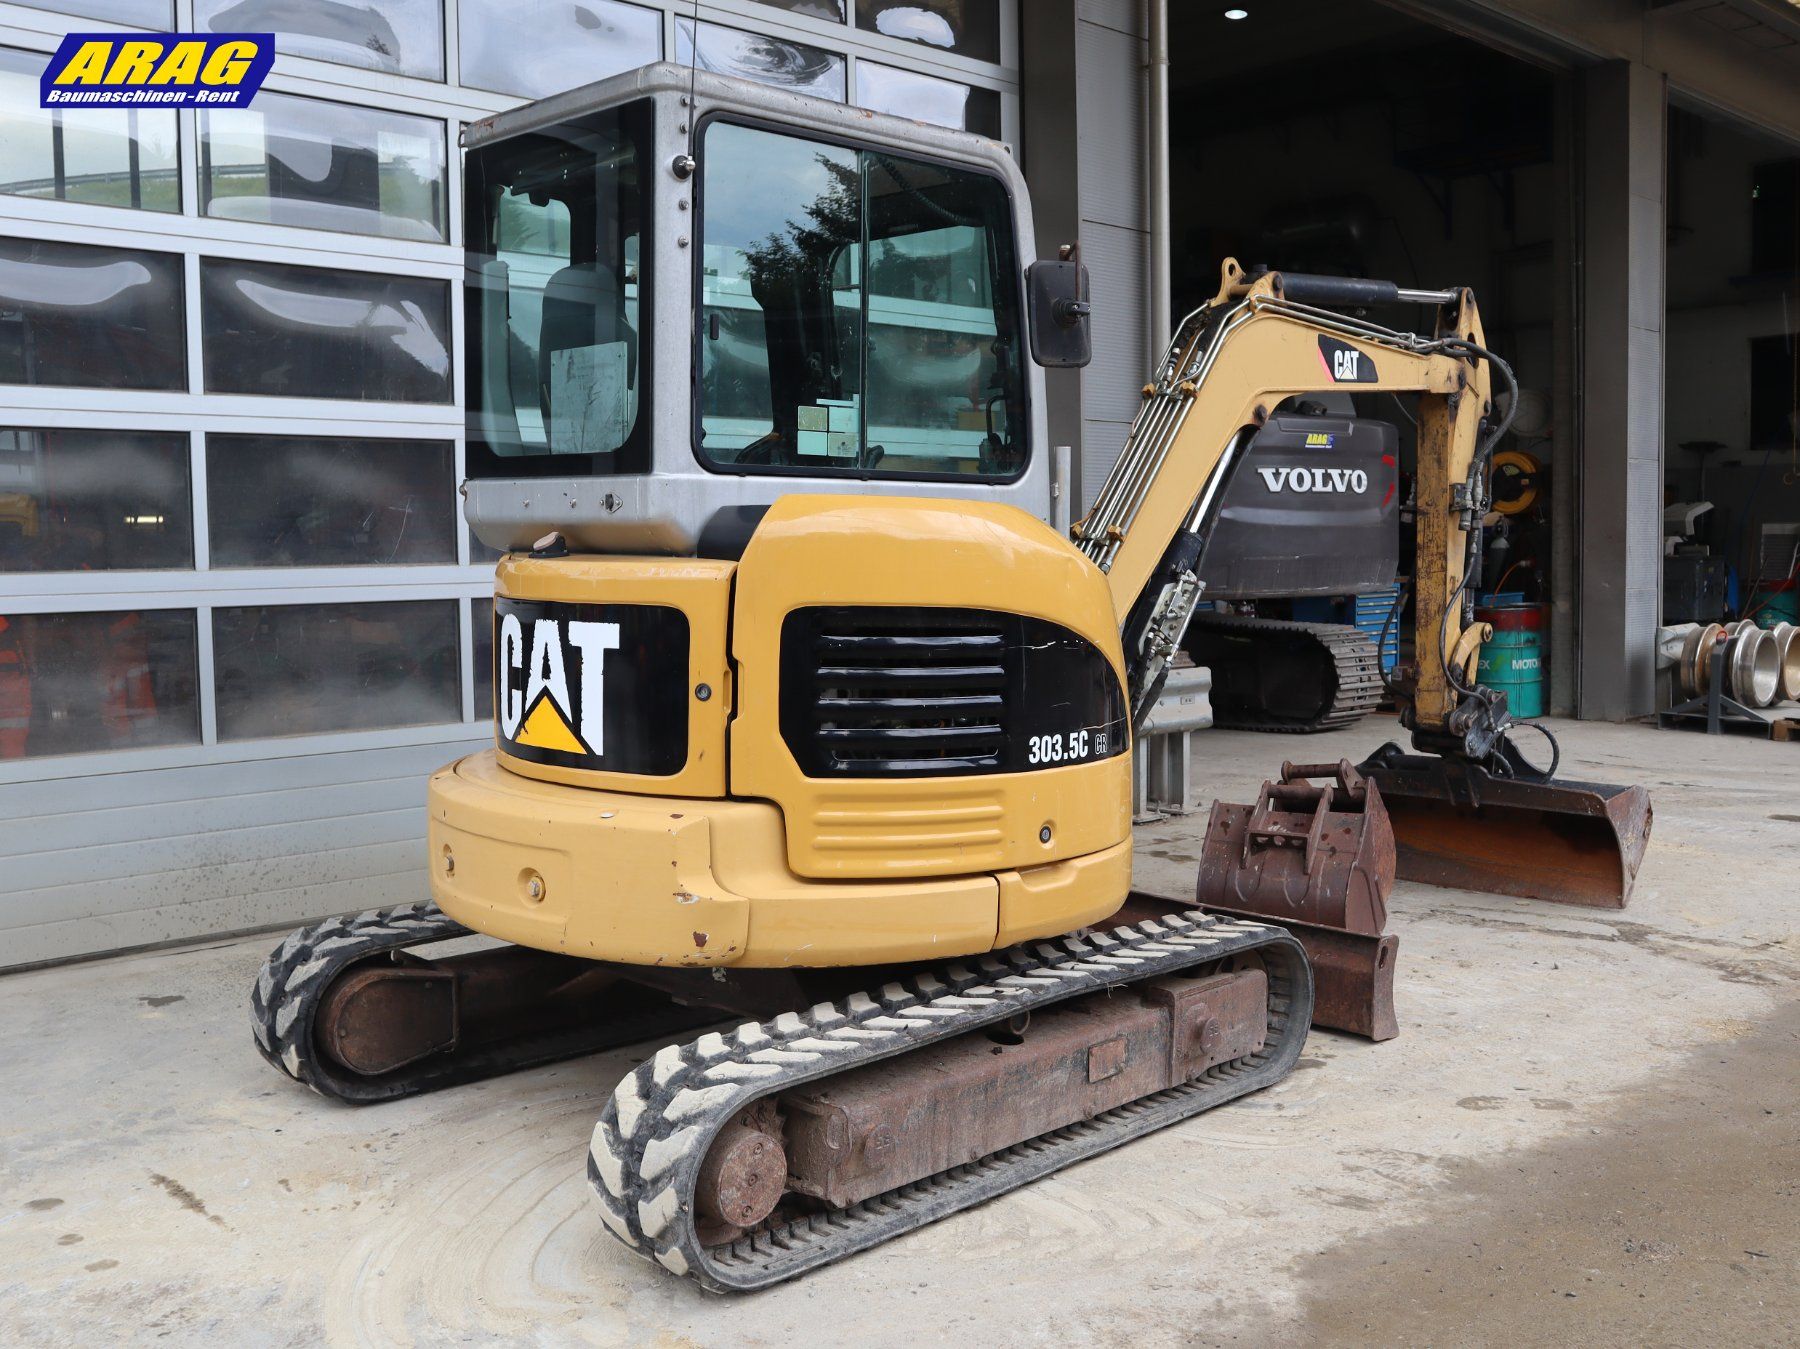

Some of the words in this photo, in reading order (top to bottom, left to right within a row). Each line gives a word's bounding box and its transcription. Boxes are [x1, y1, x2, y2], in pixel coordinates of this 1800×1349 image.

[1334, 350, 1359, 378] CAT
[1306, 433, 1327, 444] ARAG
[1257, 467, 1368, 494] VOLVO
[501, 613, 620, 756] CAT
[1029, 730, 1088, 763] 303.5C
[1095, 733, 1107, 754] CR
